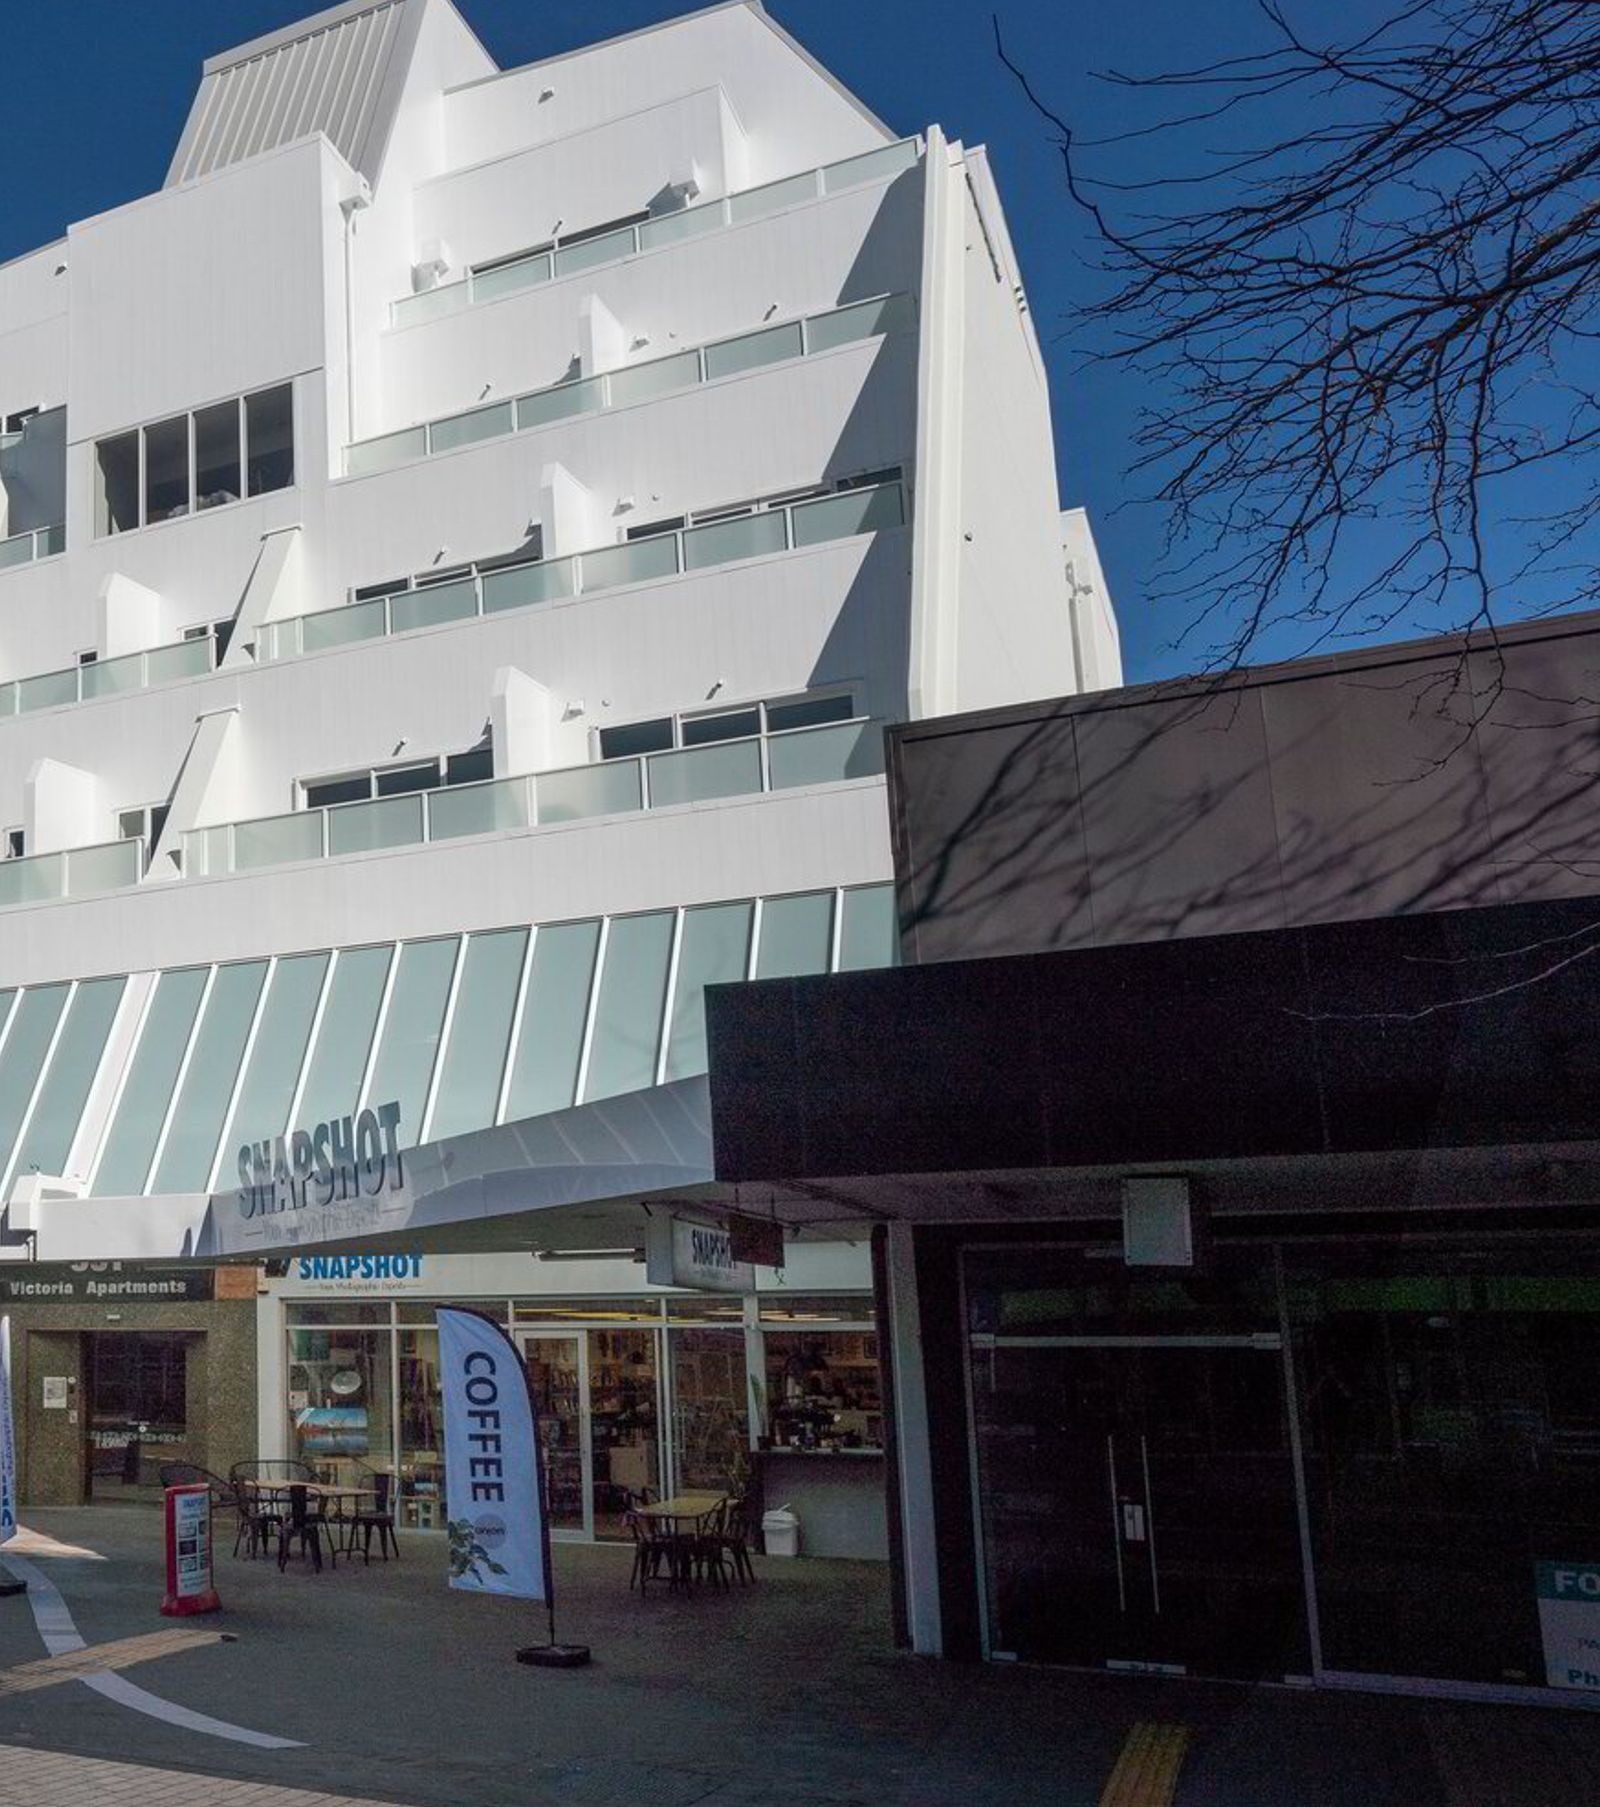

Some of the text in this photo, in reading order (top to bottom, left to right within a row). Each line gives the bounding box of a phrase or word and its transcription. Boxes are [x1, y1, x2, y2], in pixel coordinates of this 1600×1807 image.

[238, 1100, 404, 1220] SNAPSHOT
[10, 1281, 187, 1297] Victoria Apartments
[299, 1254, 423, 1280] SNAPSHOT
[463, 1351, 503, 1502] COFFEE
